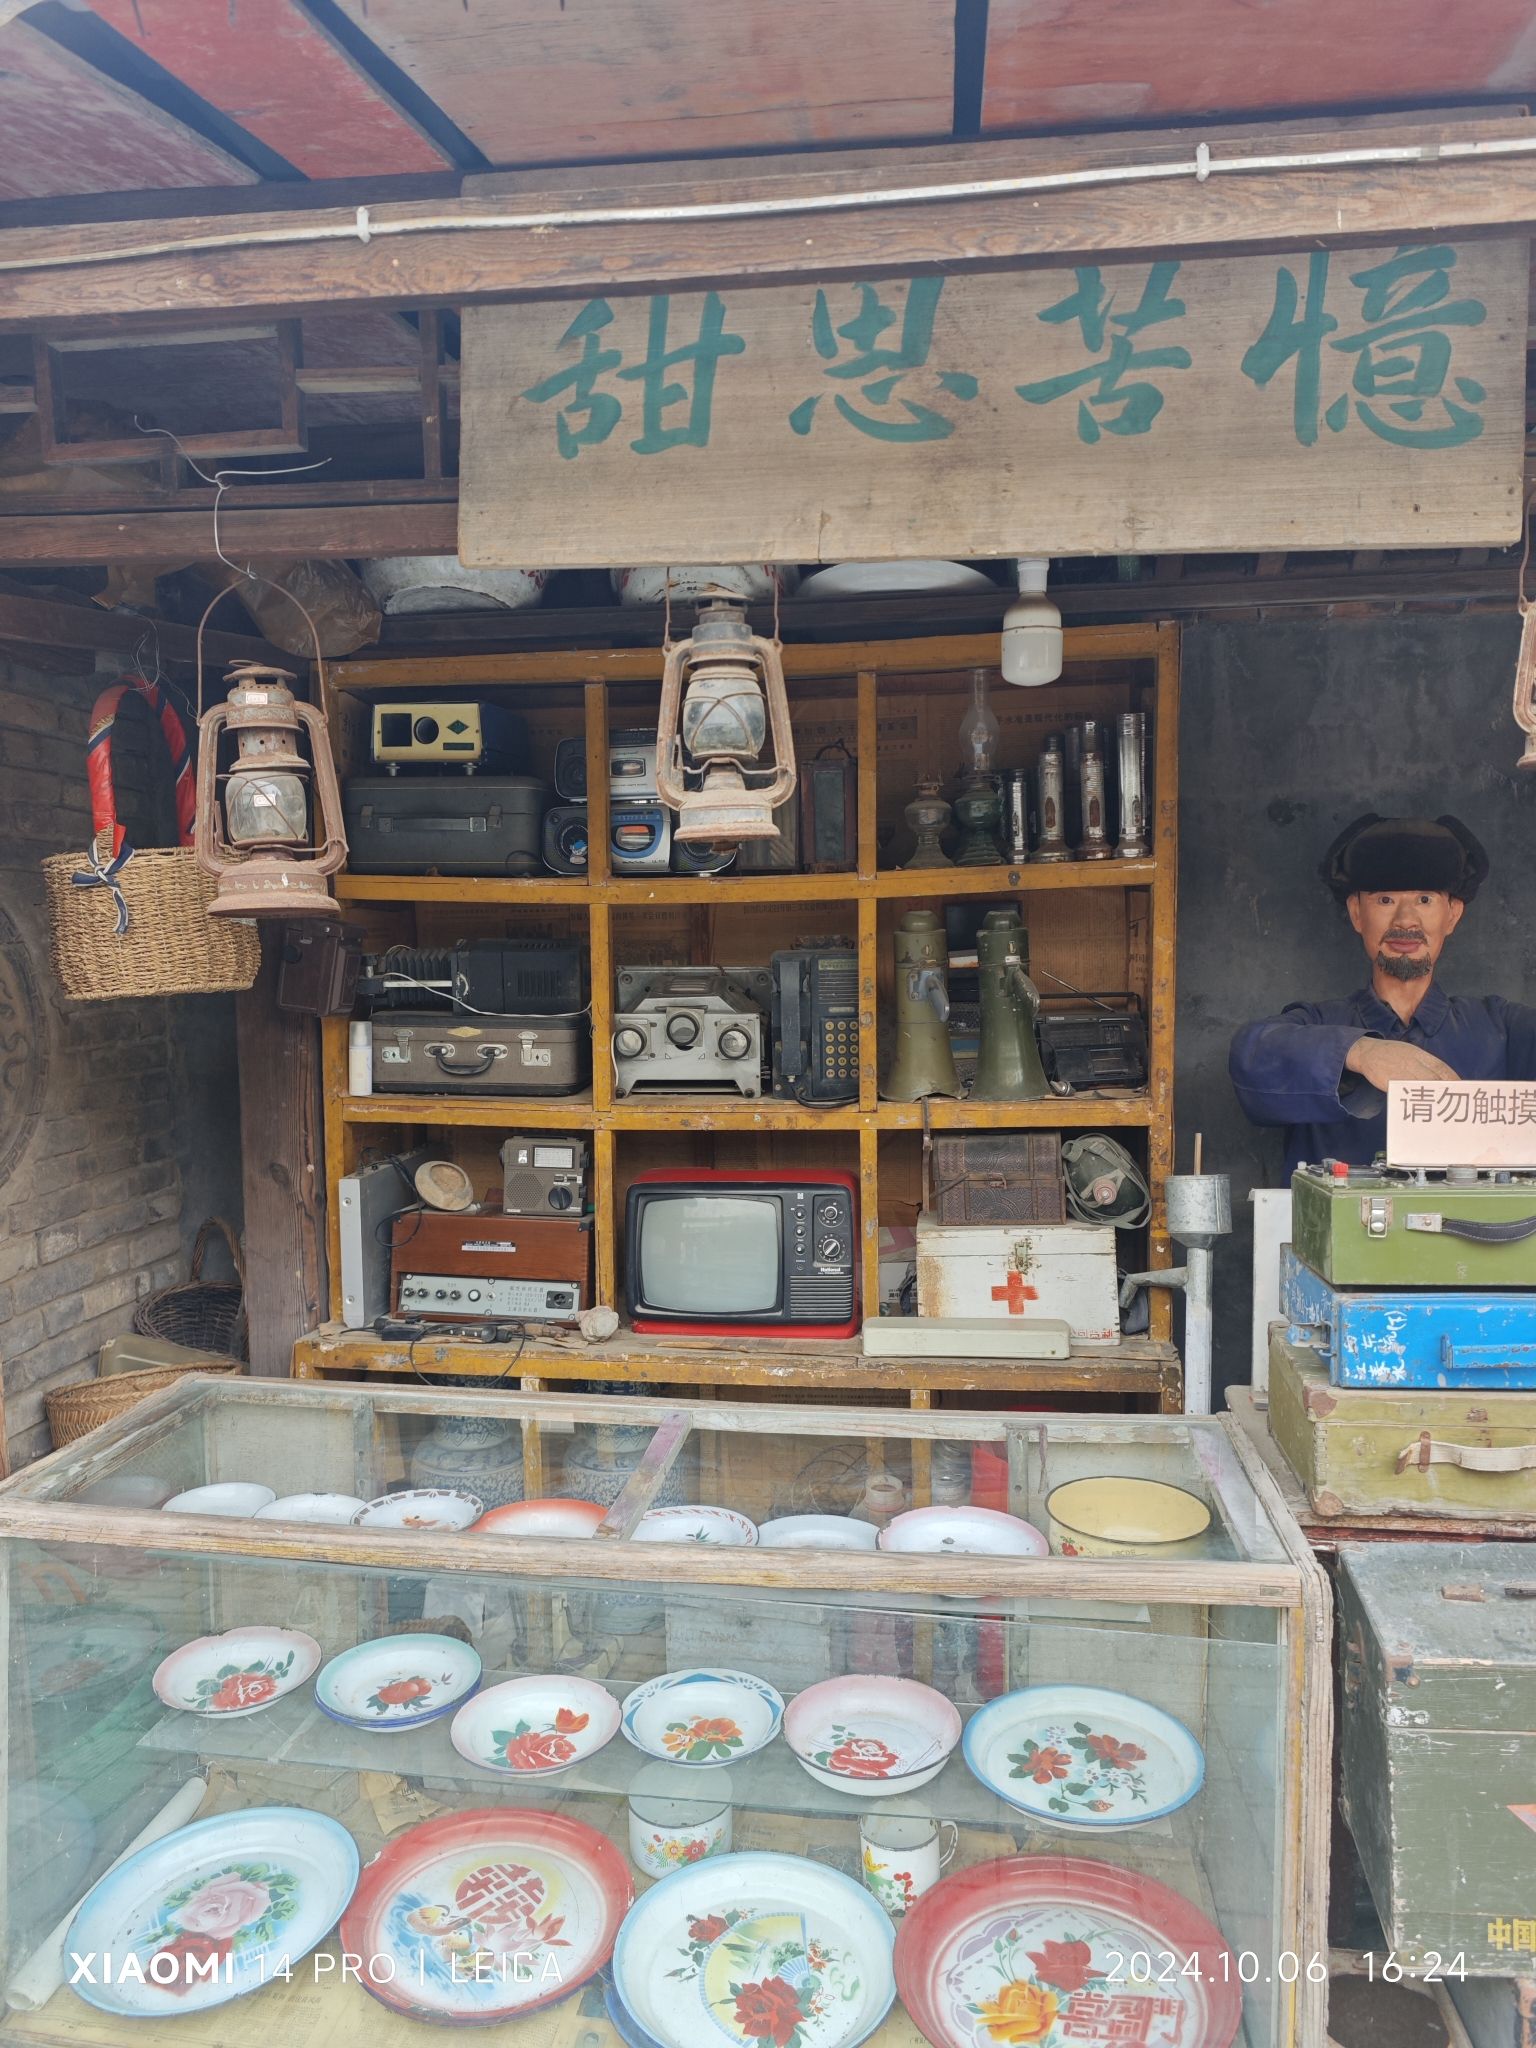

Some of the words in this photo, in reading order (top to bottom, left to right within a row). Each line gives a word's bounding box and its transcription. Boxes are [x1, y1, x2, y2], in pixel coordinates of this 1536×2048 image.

[1400, 1086, 1536, 1126] 请勿触摸
[1487, 1917, 1536, 1953] 中国
